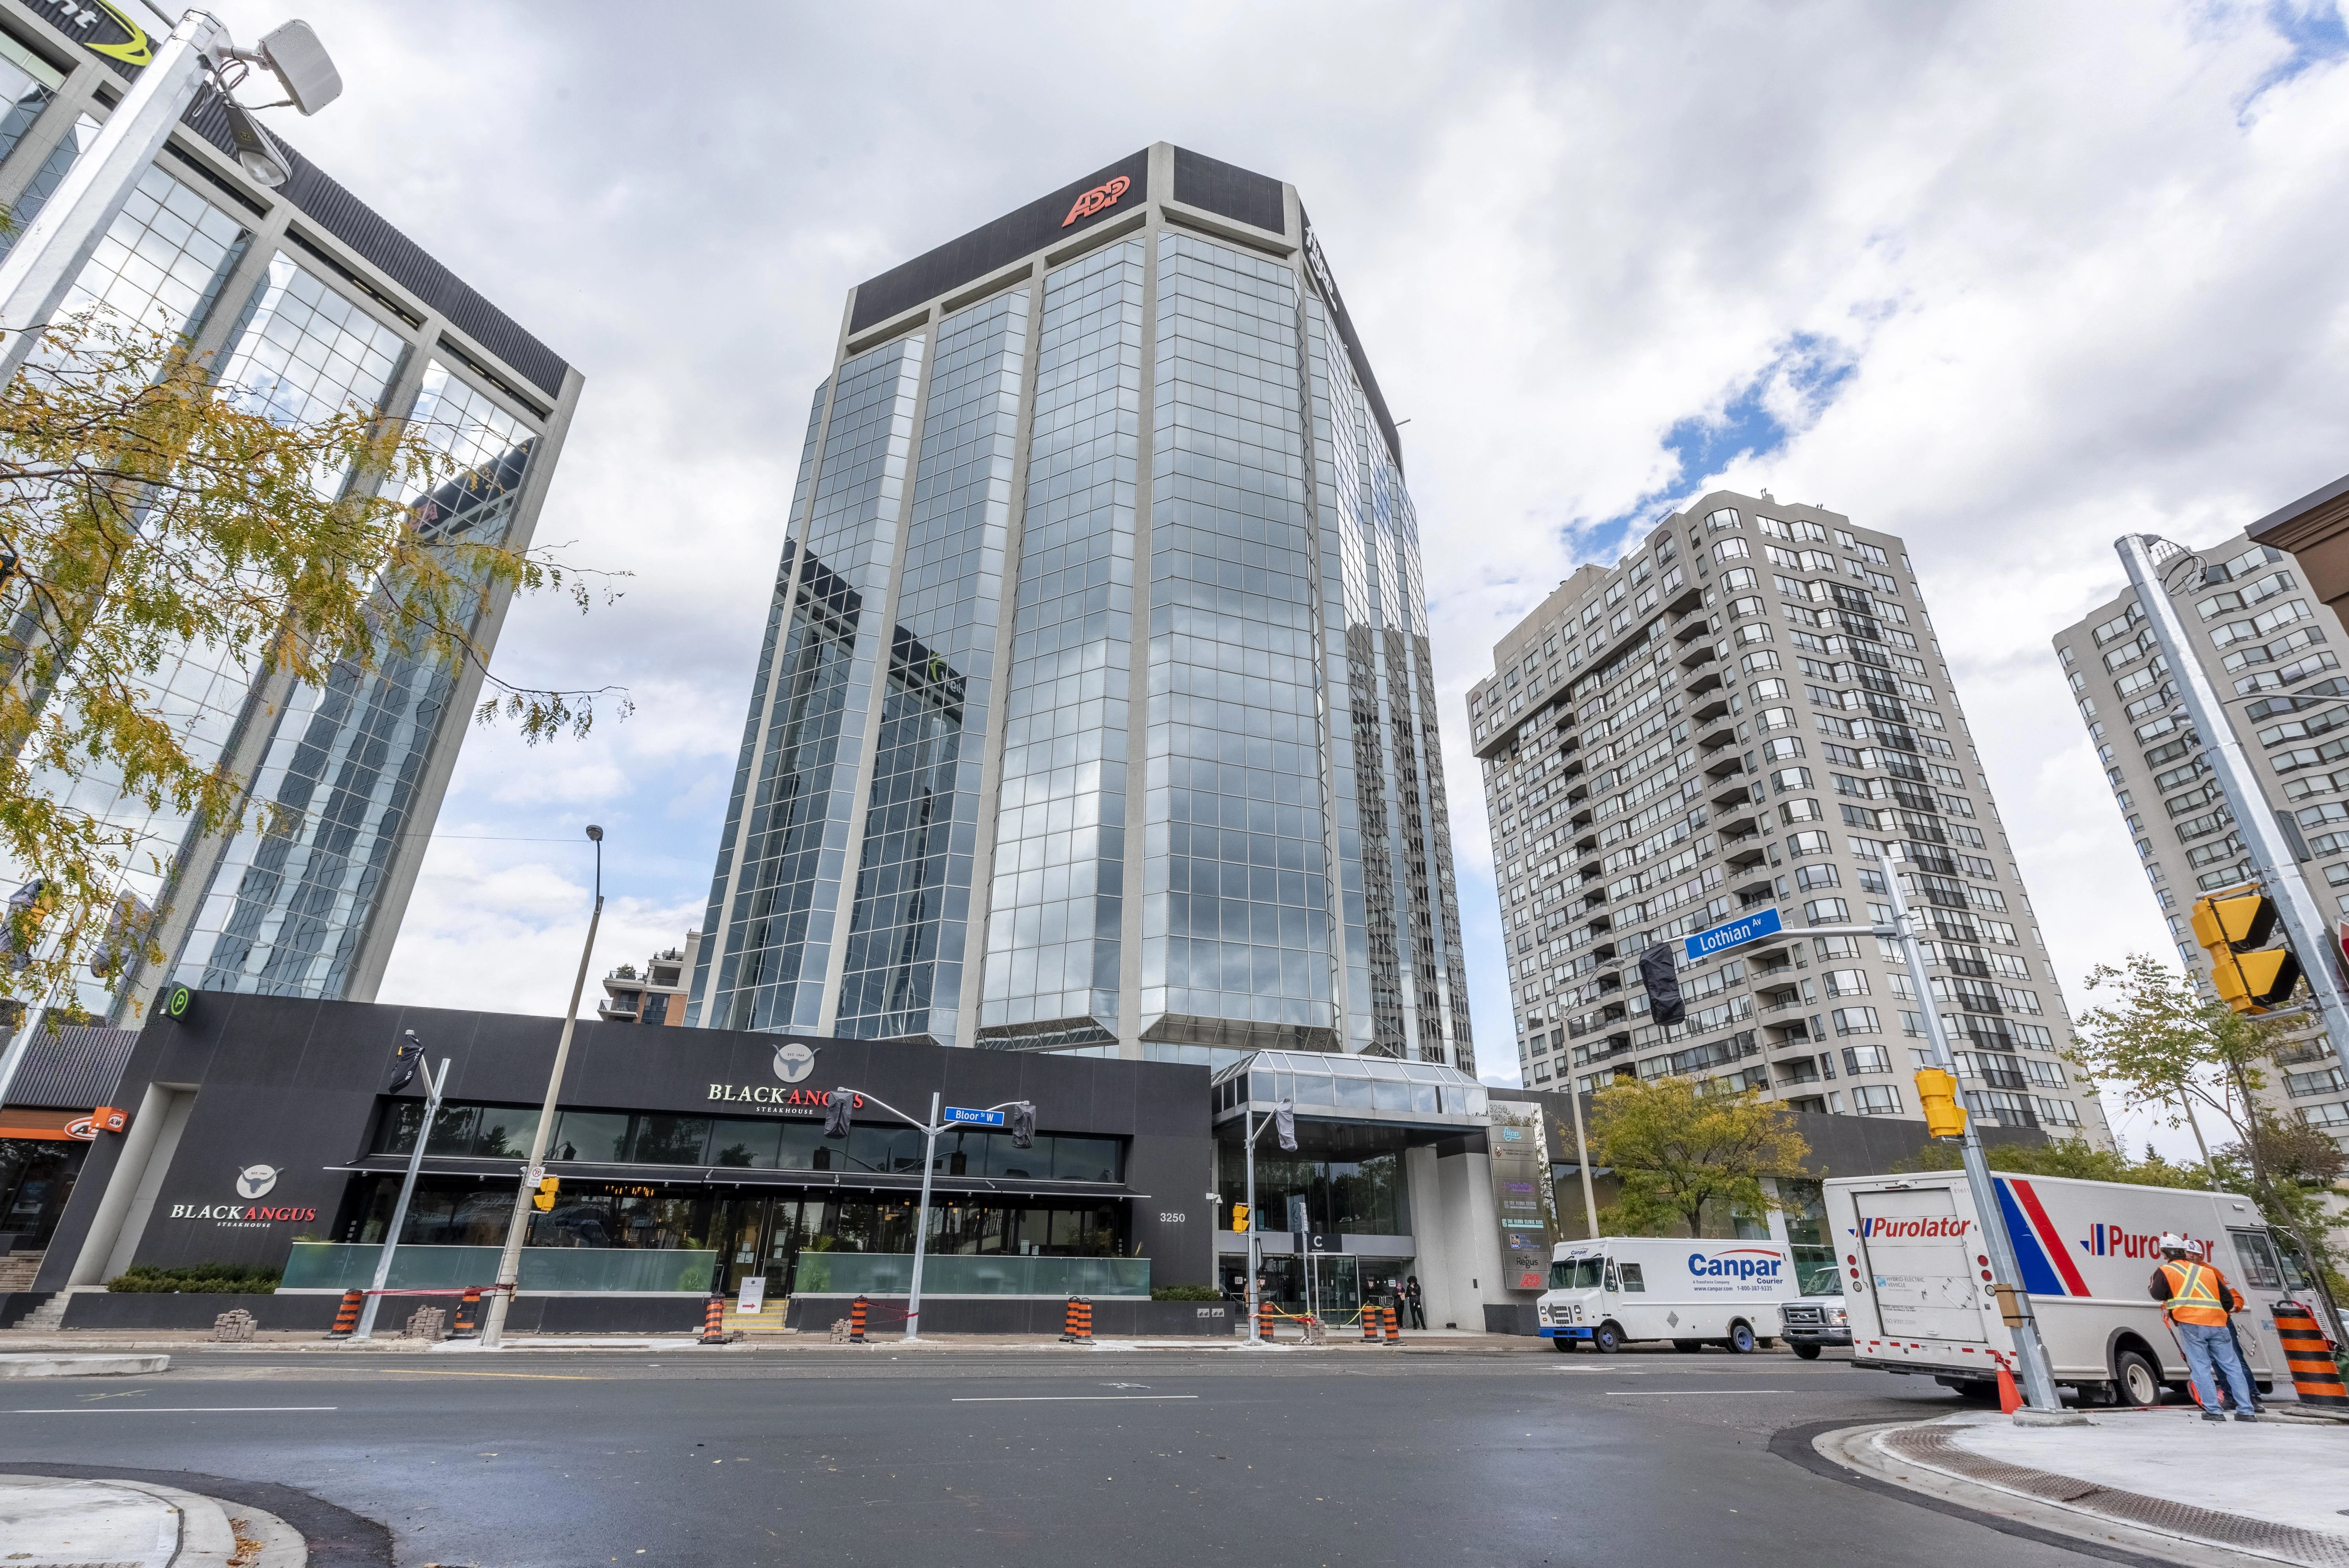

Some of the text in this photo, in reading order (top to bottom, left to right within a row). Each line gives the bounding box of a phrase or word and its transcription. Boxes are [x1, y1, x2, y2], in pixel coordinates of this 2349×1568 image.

[1062, 176, 1130, 227] ADP
[1700, 918, 1761, 951] Lothian Av
[707, 1084, 786, 1104] BLACK
[756, 1106, 813, 1115] STEAKHOUSE
[1489, 1104, 1507, 1113] 3250
[956, 1110, 979, 1120] Bloor
[986, 1113, 994, 1122] W
[1503, 1127, 1521, 1142] flipp
[170, 1204, 316, 1222] BLACK ANGUS
[1160, 1213, 1185, 1223] 3250
[1872, 1217, 1971, 1237] Purolator
[1314, 1235, 1323, 1247] C
[1516, 1257, 1539, 1269] Regus
[1688, 1253, 1781, 1280] Canpar
[1520, 1274, 1541, 1287] ADP
